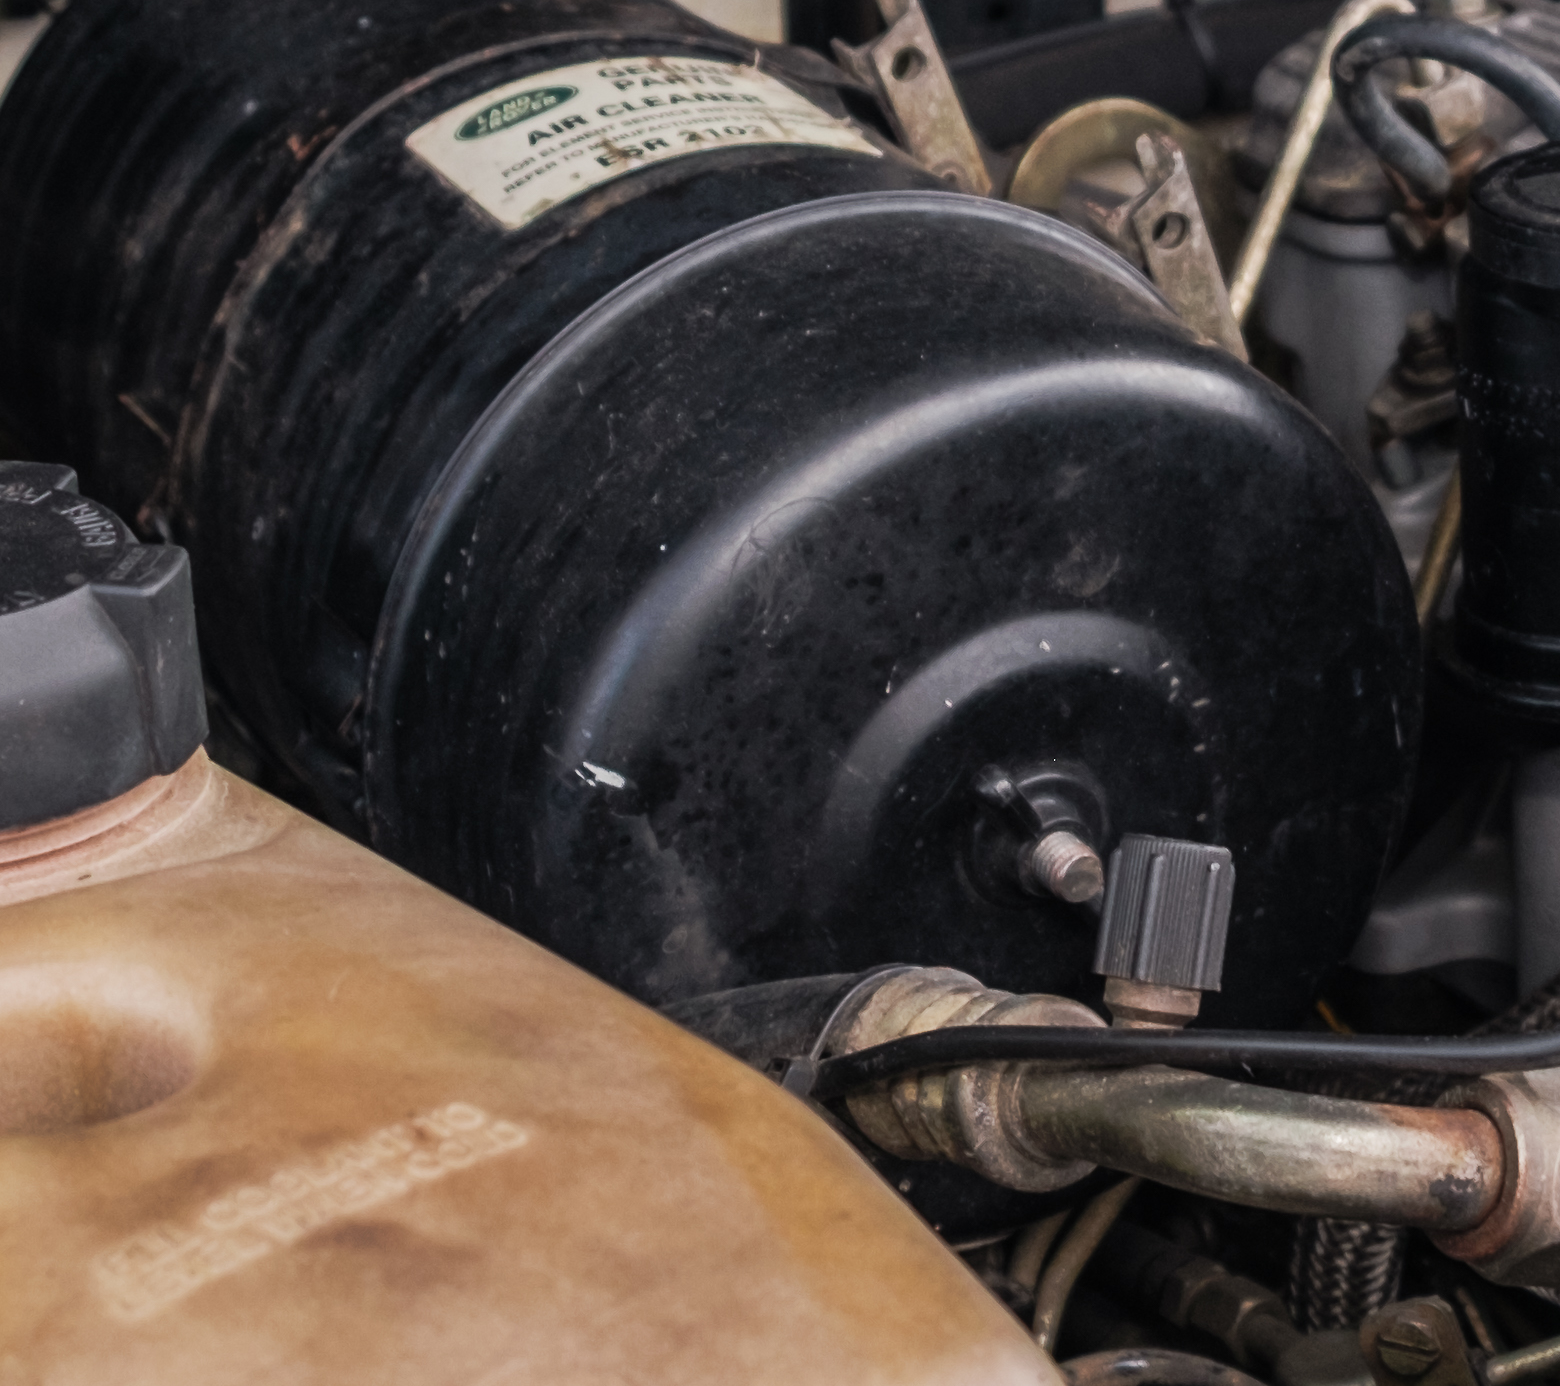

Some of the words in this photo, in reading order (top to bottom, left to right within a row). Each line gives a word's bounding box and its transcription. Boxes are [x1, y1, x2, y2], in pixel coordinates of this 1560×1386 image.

[527, 114, 588, 147] AIR
[596, 93, 766, 118] CLEANER
[501, 156, 536, 179] FOR
